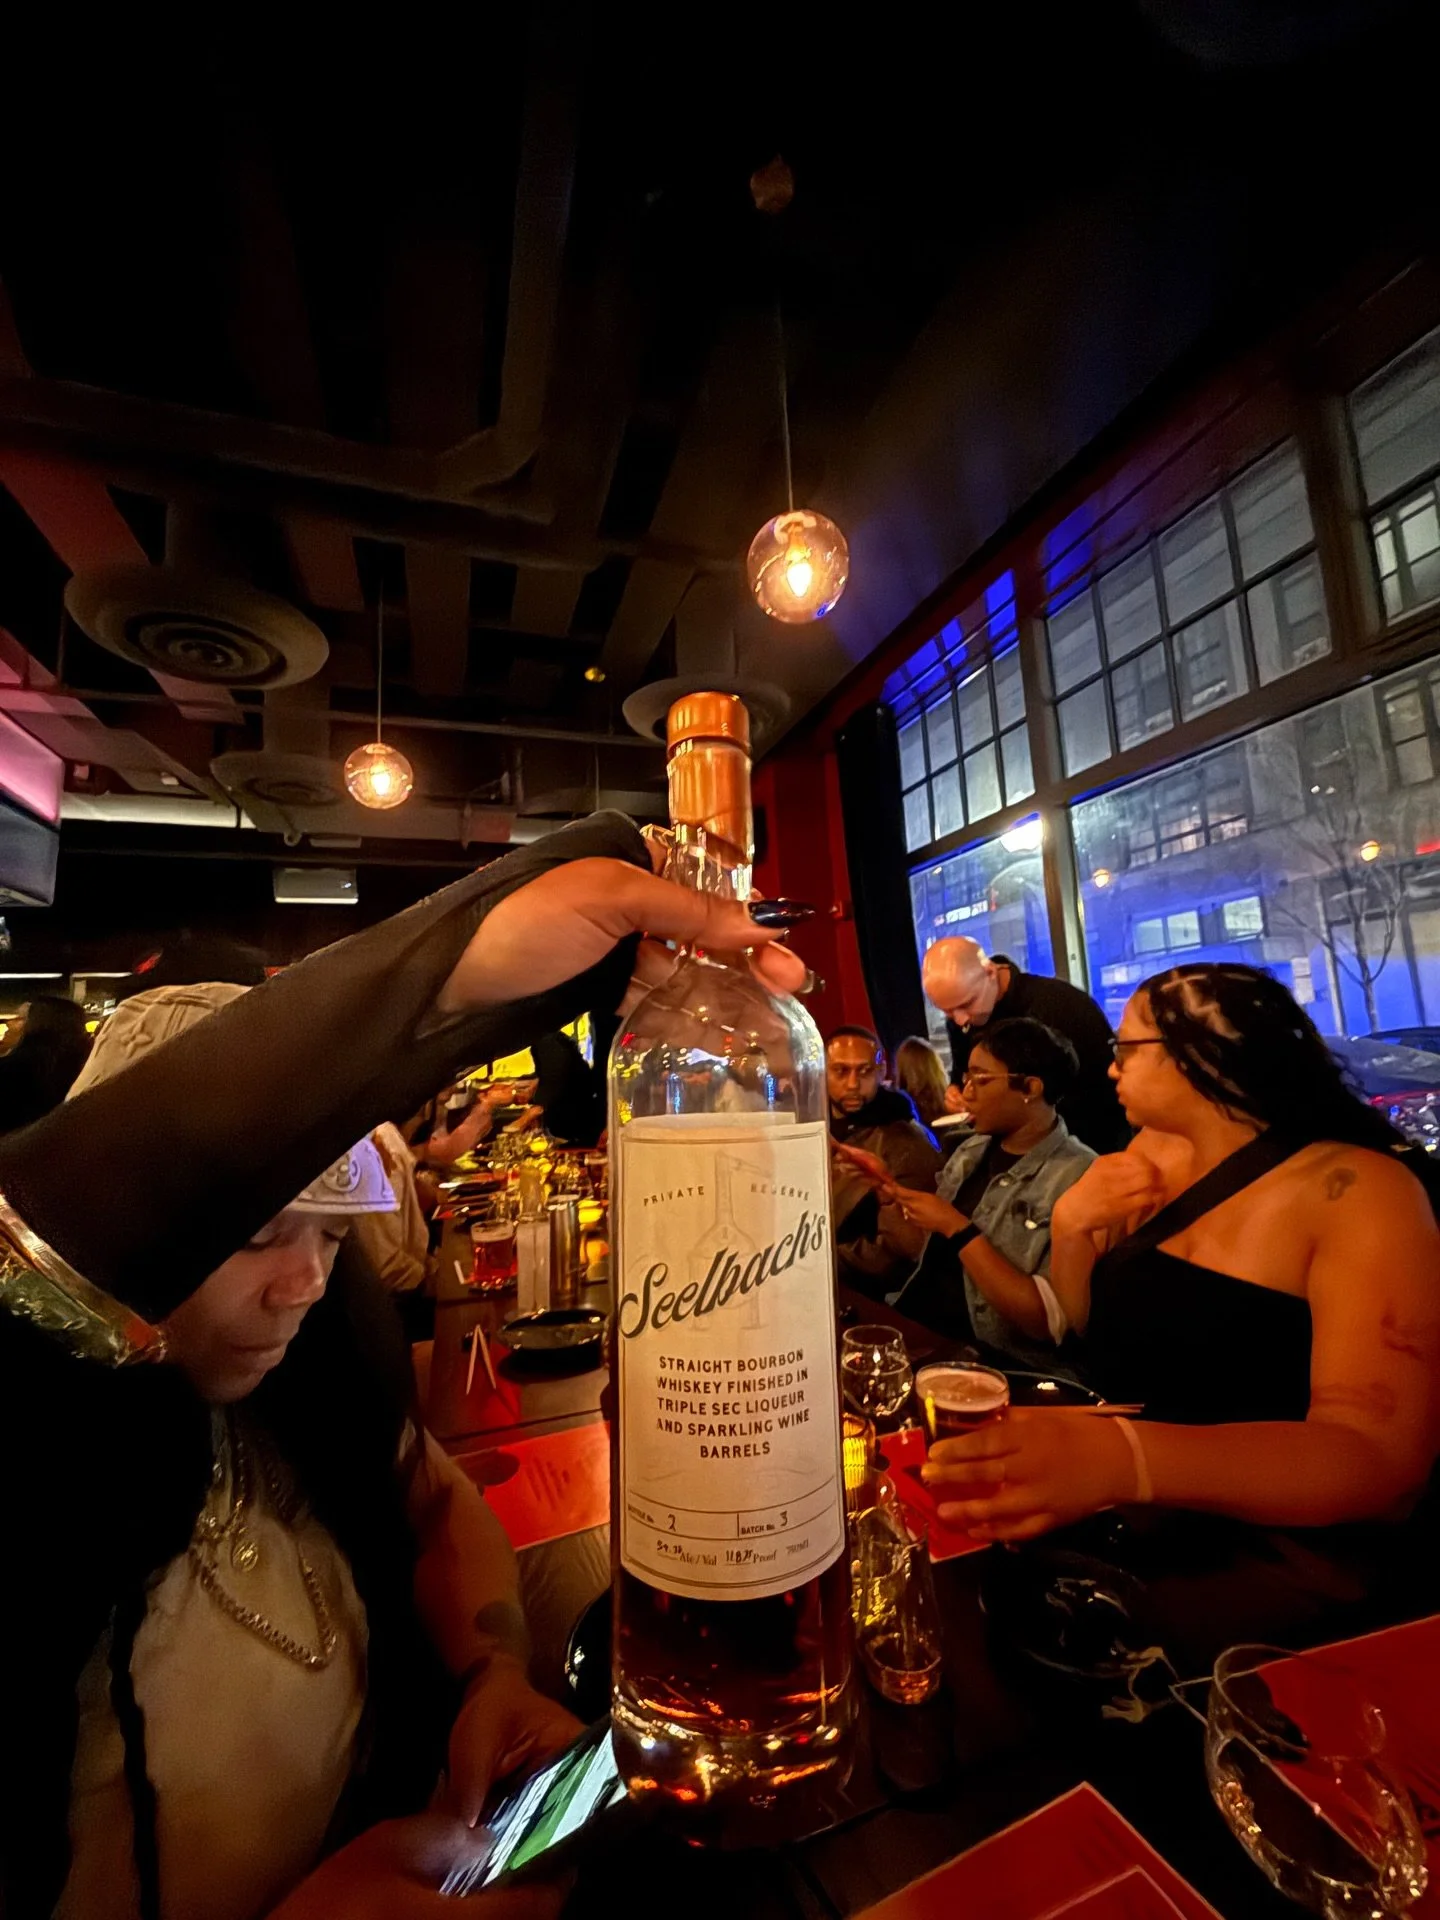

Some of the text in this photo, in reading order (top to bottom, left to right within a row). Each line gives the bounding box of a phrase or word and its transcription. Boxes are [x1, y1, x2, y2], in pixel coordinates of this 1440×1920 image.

[643, 1183, 809, 1206] PRIVATE RESERVE
[618, 1210, 827, 1339] Seelbach's
[659, 1349, 804, 1373] STRAIGHT BOURBON
[657, 1368, 808, 1394] WHISKEY FINISHED IN
[657, 1390, 805, 1416] TRIPLE SEC LIQUEUR
[657, 1408, 810, 1437] AND SPARKLING WINE
[700, 1441, 770, 1459] BARRELS
[668, 1513, 676, 1532] 2
[780, 1510, 788, 1527] 3
